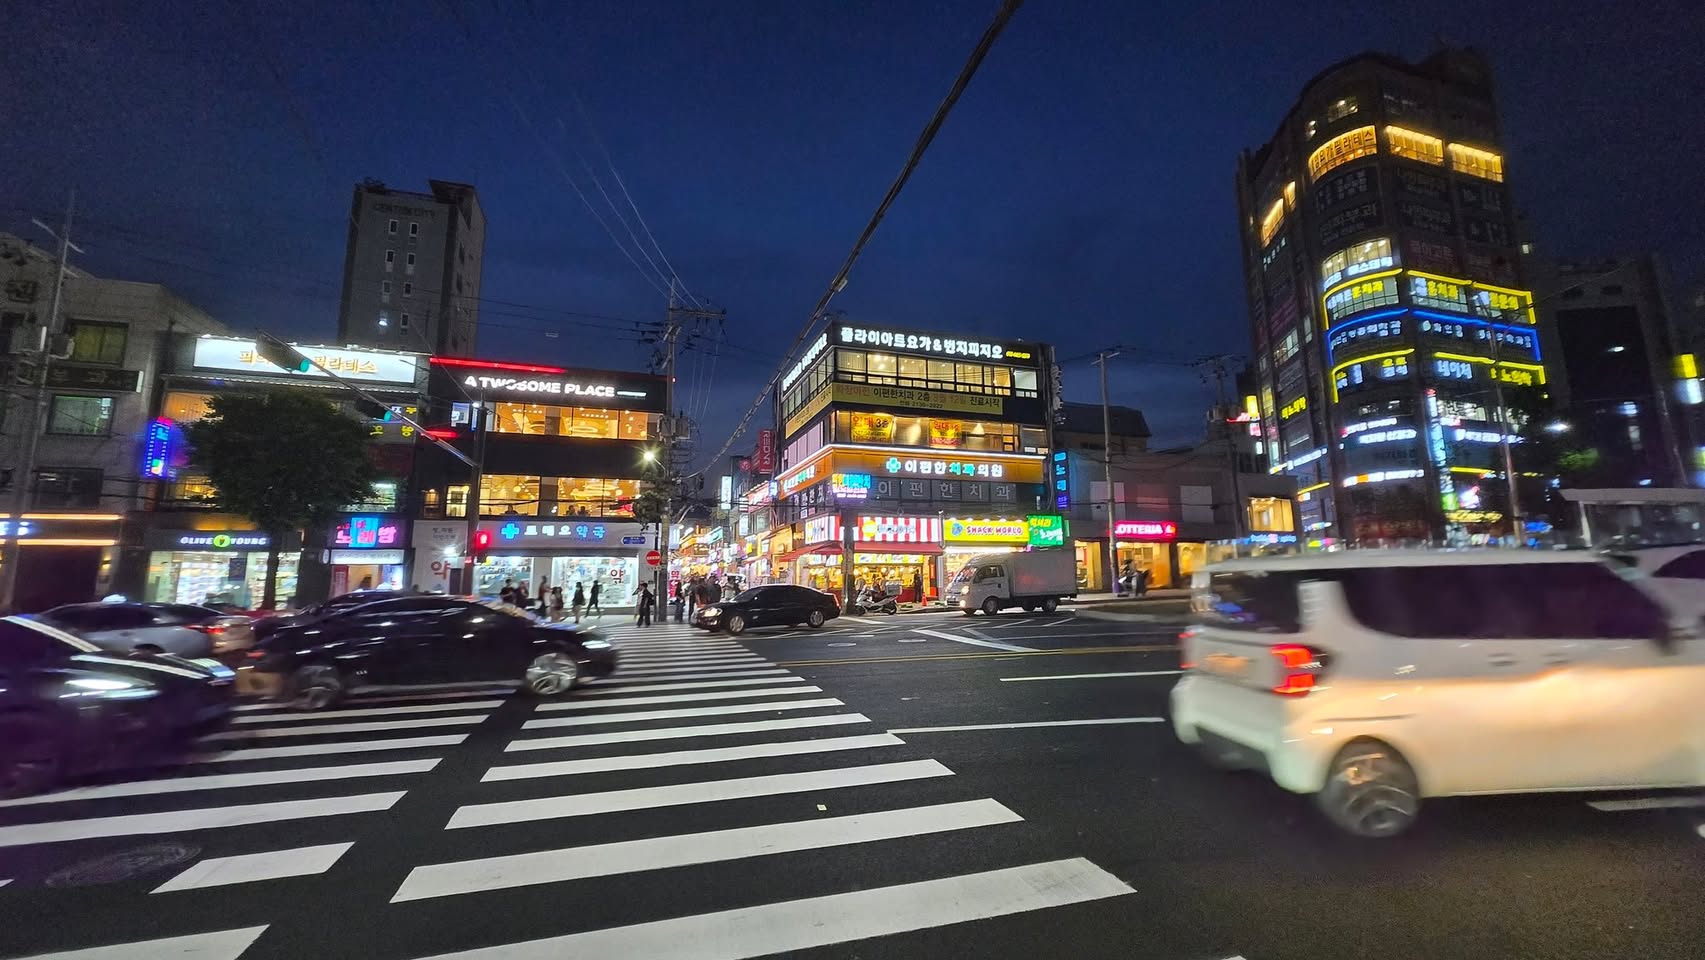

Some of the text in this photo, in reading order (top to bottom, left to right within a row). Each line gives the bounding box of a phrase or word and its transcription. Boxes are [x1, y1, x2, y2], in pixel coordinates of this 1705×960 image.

[464, 376, 615, 397] A TWOSOME PLACE
[1114, 523, 1164, 535] OTTERIA
[180, 536, 267, 545] OLIVE YOUNG
